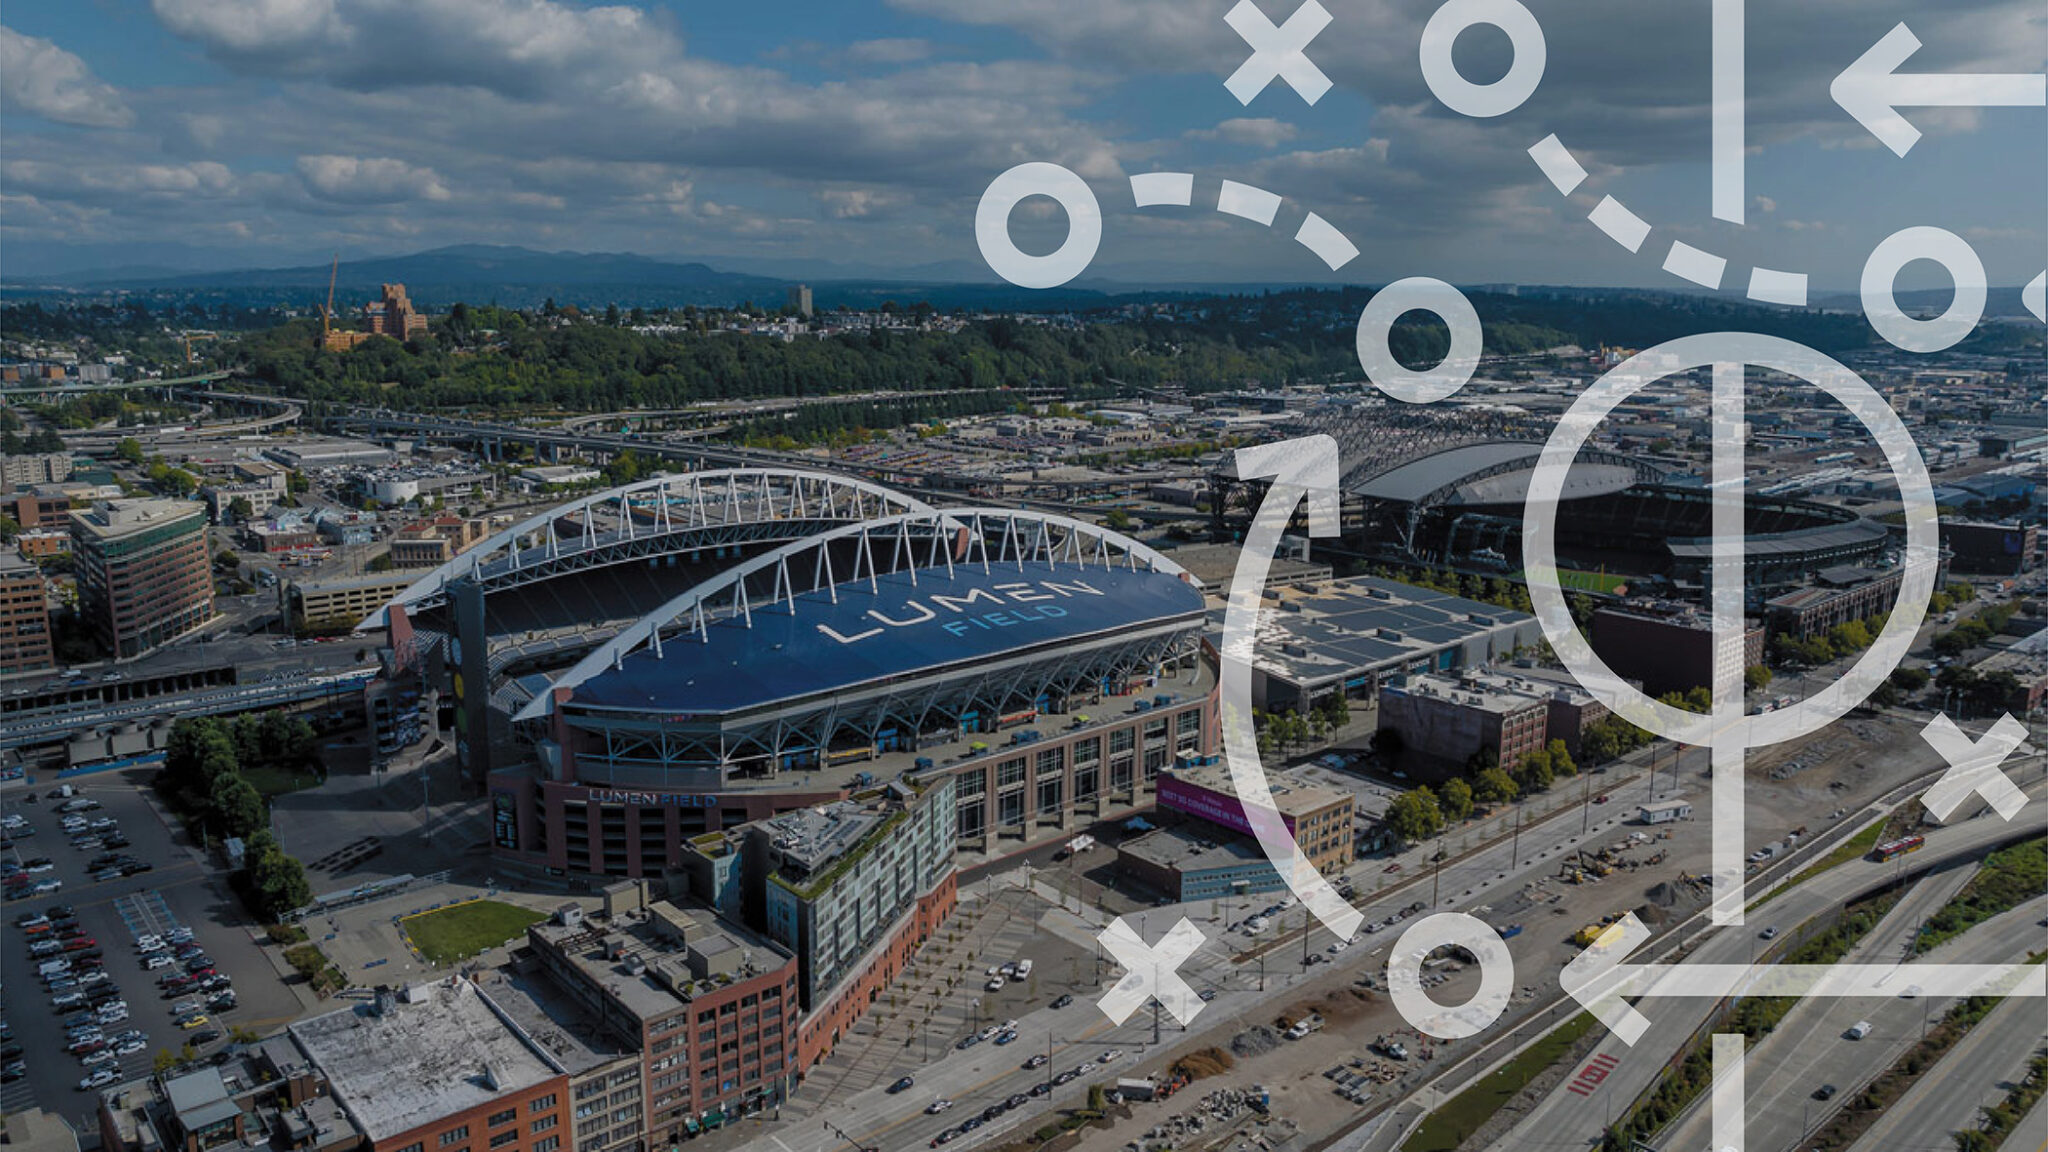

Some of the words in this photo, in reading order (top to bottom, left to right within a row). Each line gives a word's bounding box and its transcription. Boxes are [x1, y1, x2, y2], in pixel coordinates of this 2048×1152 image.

[816, 579, 1105, 643] LUMEN
[942, 605, 1068, 637] FIELD
[589, 788, 657, 805] LUMEN
[661, 794, 718, 808] FIELD
